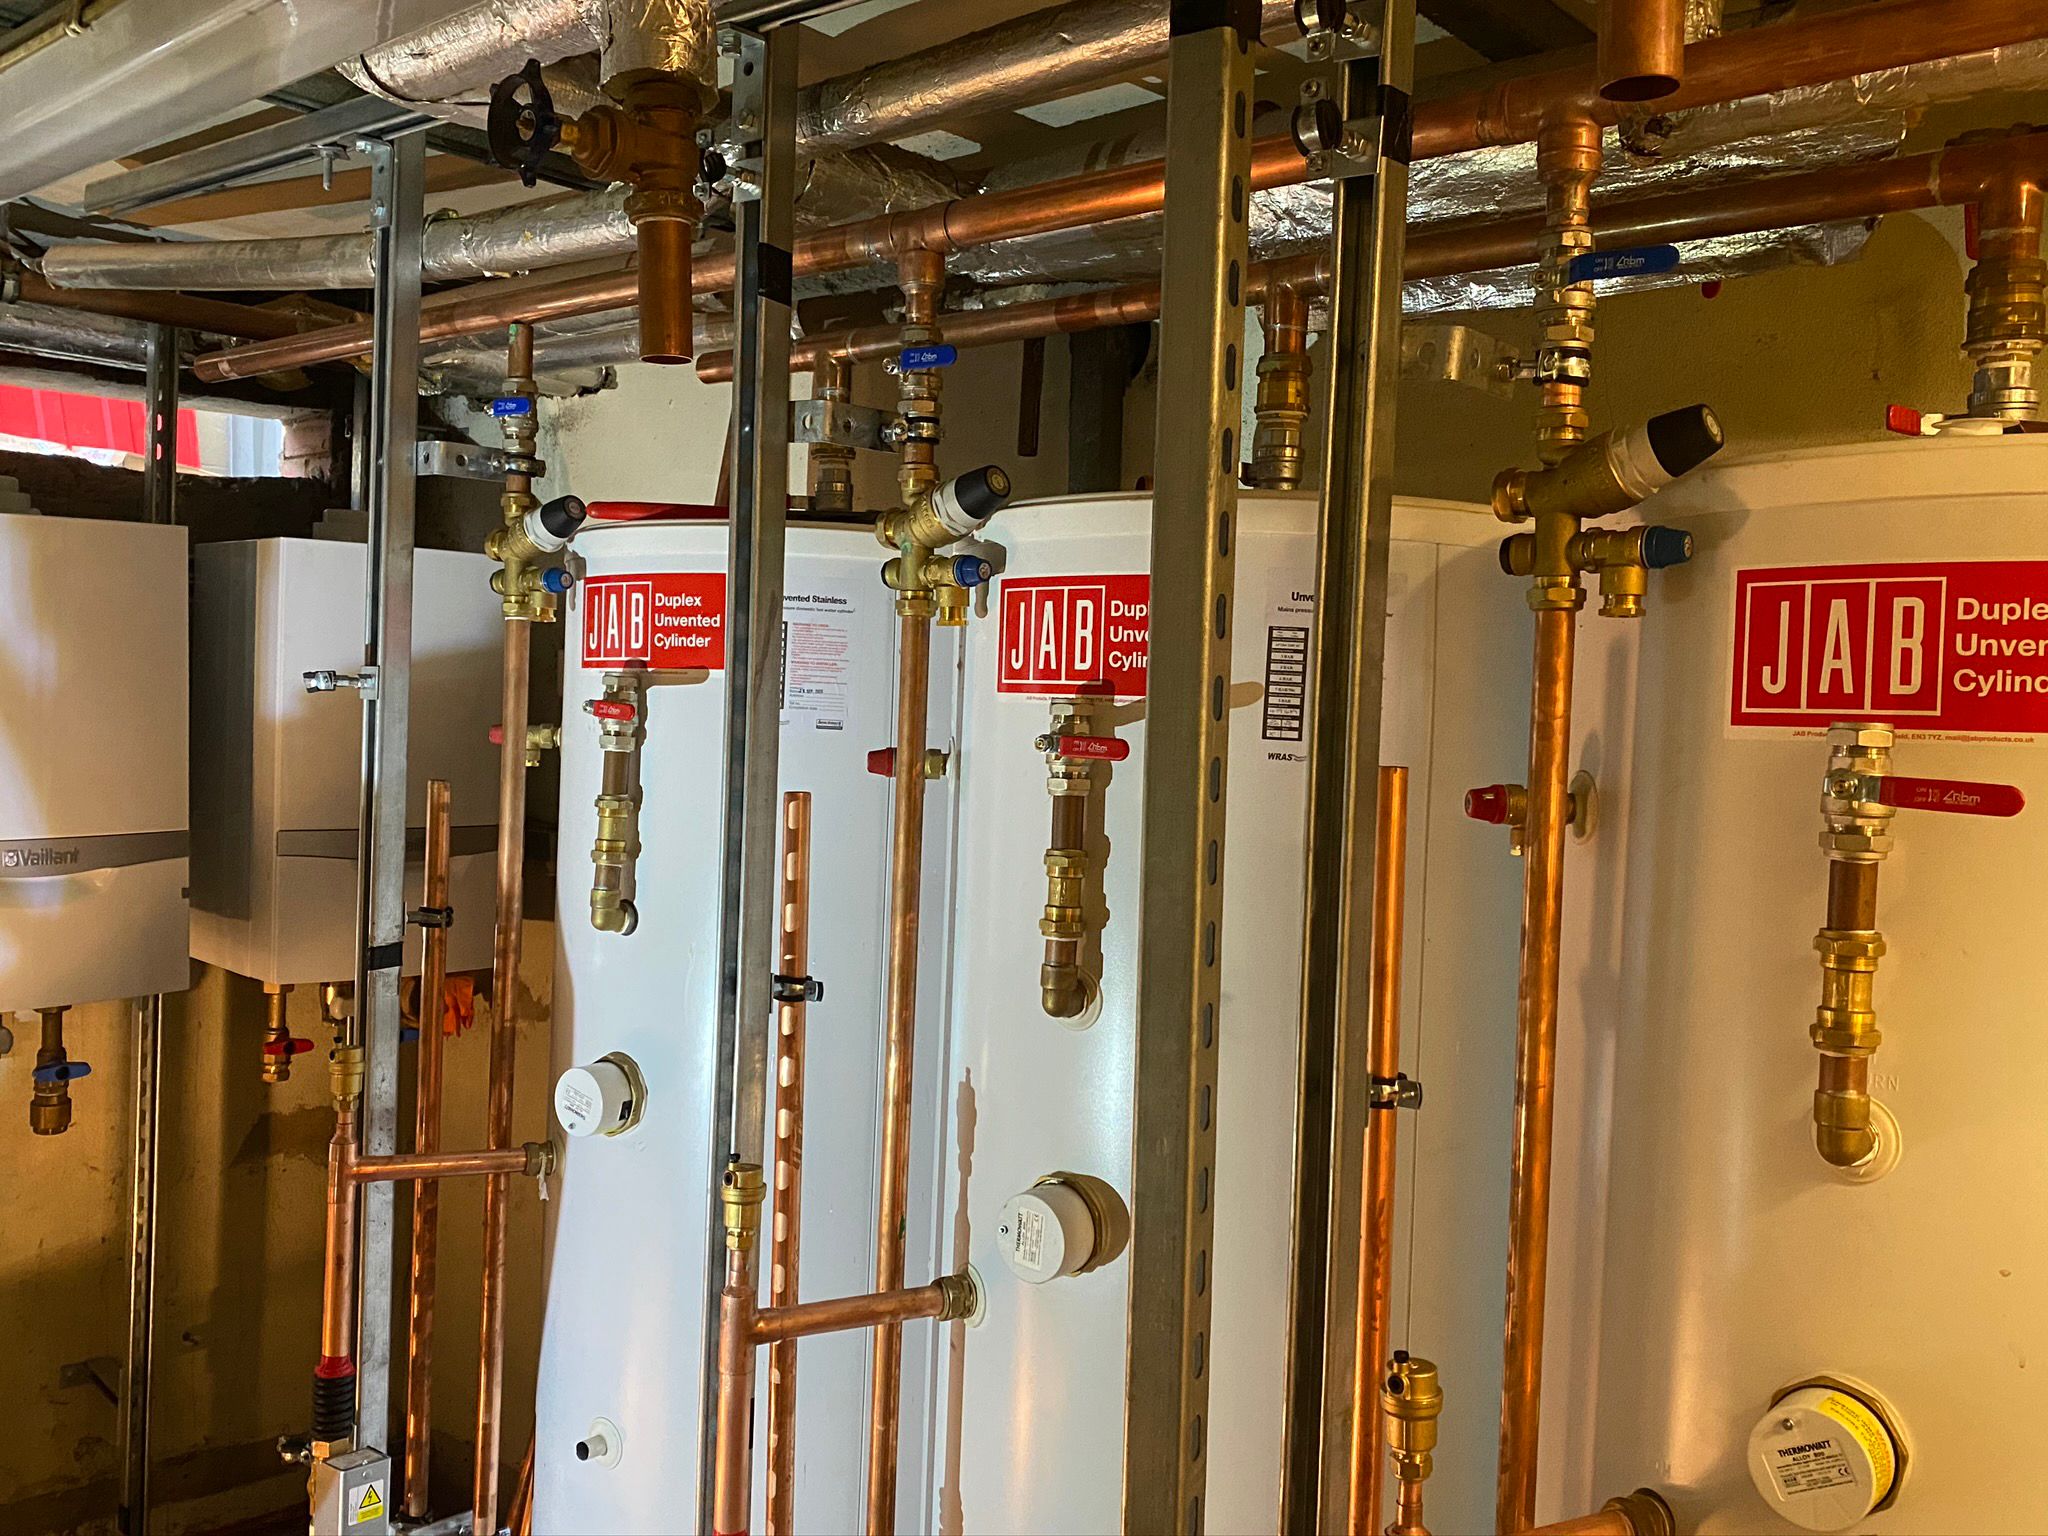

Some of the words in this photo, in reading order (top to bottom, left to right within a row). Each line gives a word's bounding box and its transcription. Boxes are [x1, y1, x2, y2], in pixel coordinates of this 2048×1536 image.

[655, 593, 702, 609] Duplex
[783, 595, 811, 603] vented
[589, 592, 644, 650] JAB
[654, 613, 721, 627] Unvented
[654, 633, 711, 649] Cylinder
[1011, 599, 1094, 671] JAB
[1761, 596, 1926, 695] JAB
[1267, 752, 1293, 761] WRAS
[19, 847, 79, 867] Vaillant
[1777, 1440, 1831, 1457] THERMOWATT
